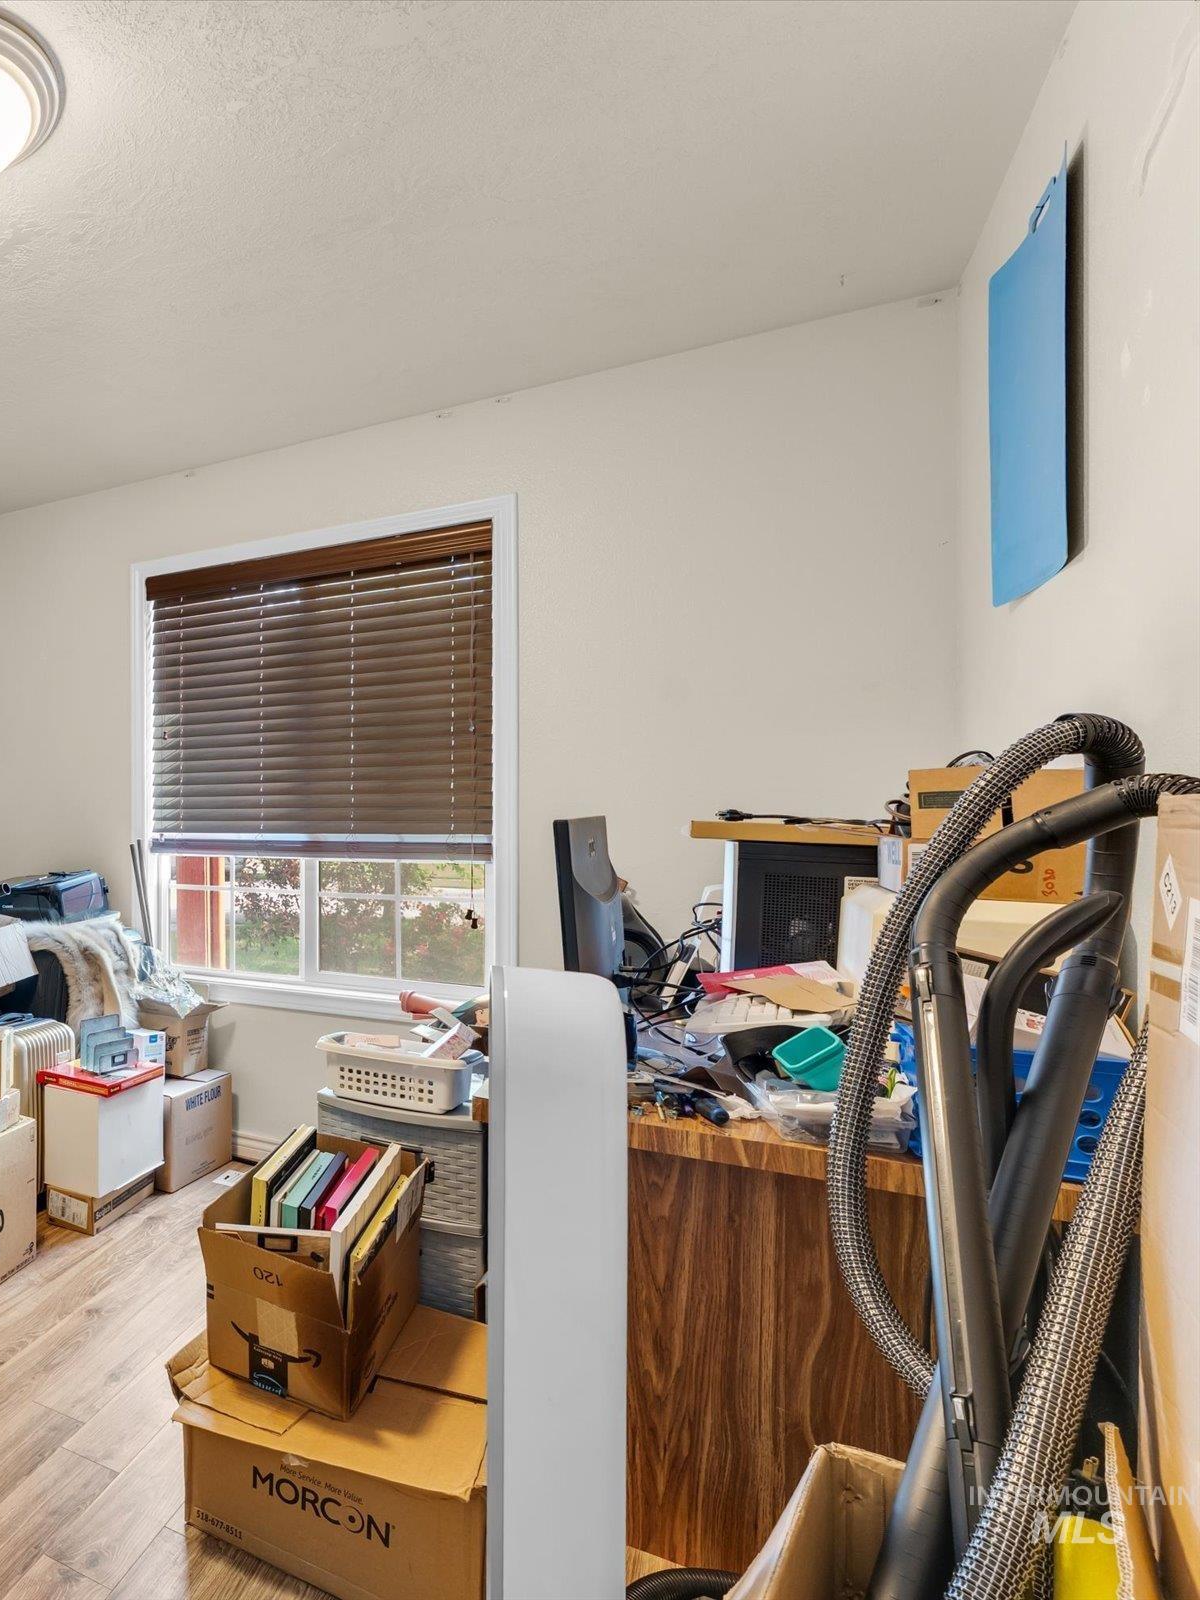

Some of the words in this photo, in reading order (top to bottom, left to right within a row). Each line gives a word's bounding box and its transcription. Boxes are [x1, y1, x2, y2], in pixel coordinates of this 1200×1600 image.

[184, 1092, 204, 1111] WHITE
[204, 1085, 222, 1103] FLOUR
[253, 1266, 284, 1287] 120
[280, 1463, 298, 1478] More
[325, 1482, 342, 1496] More
[252, 1465, 390, 1548] MORCON
